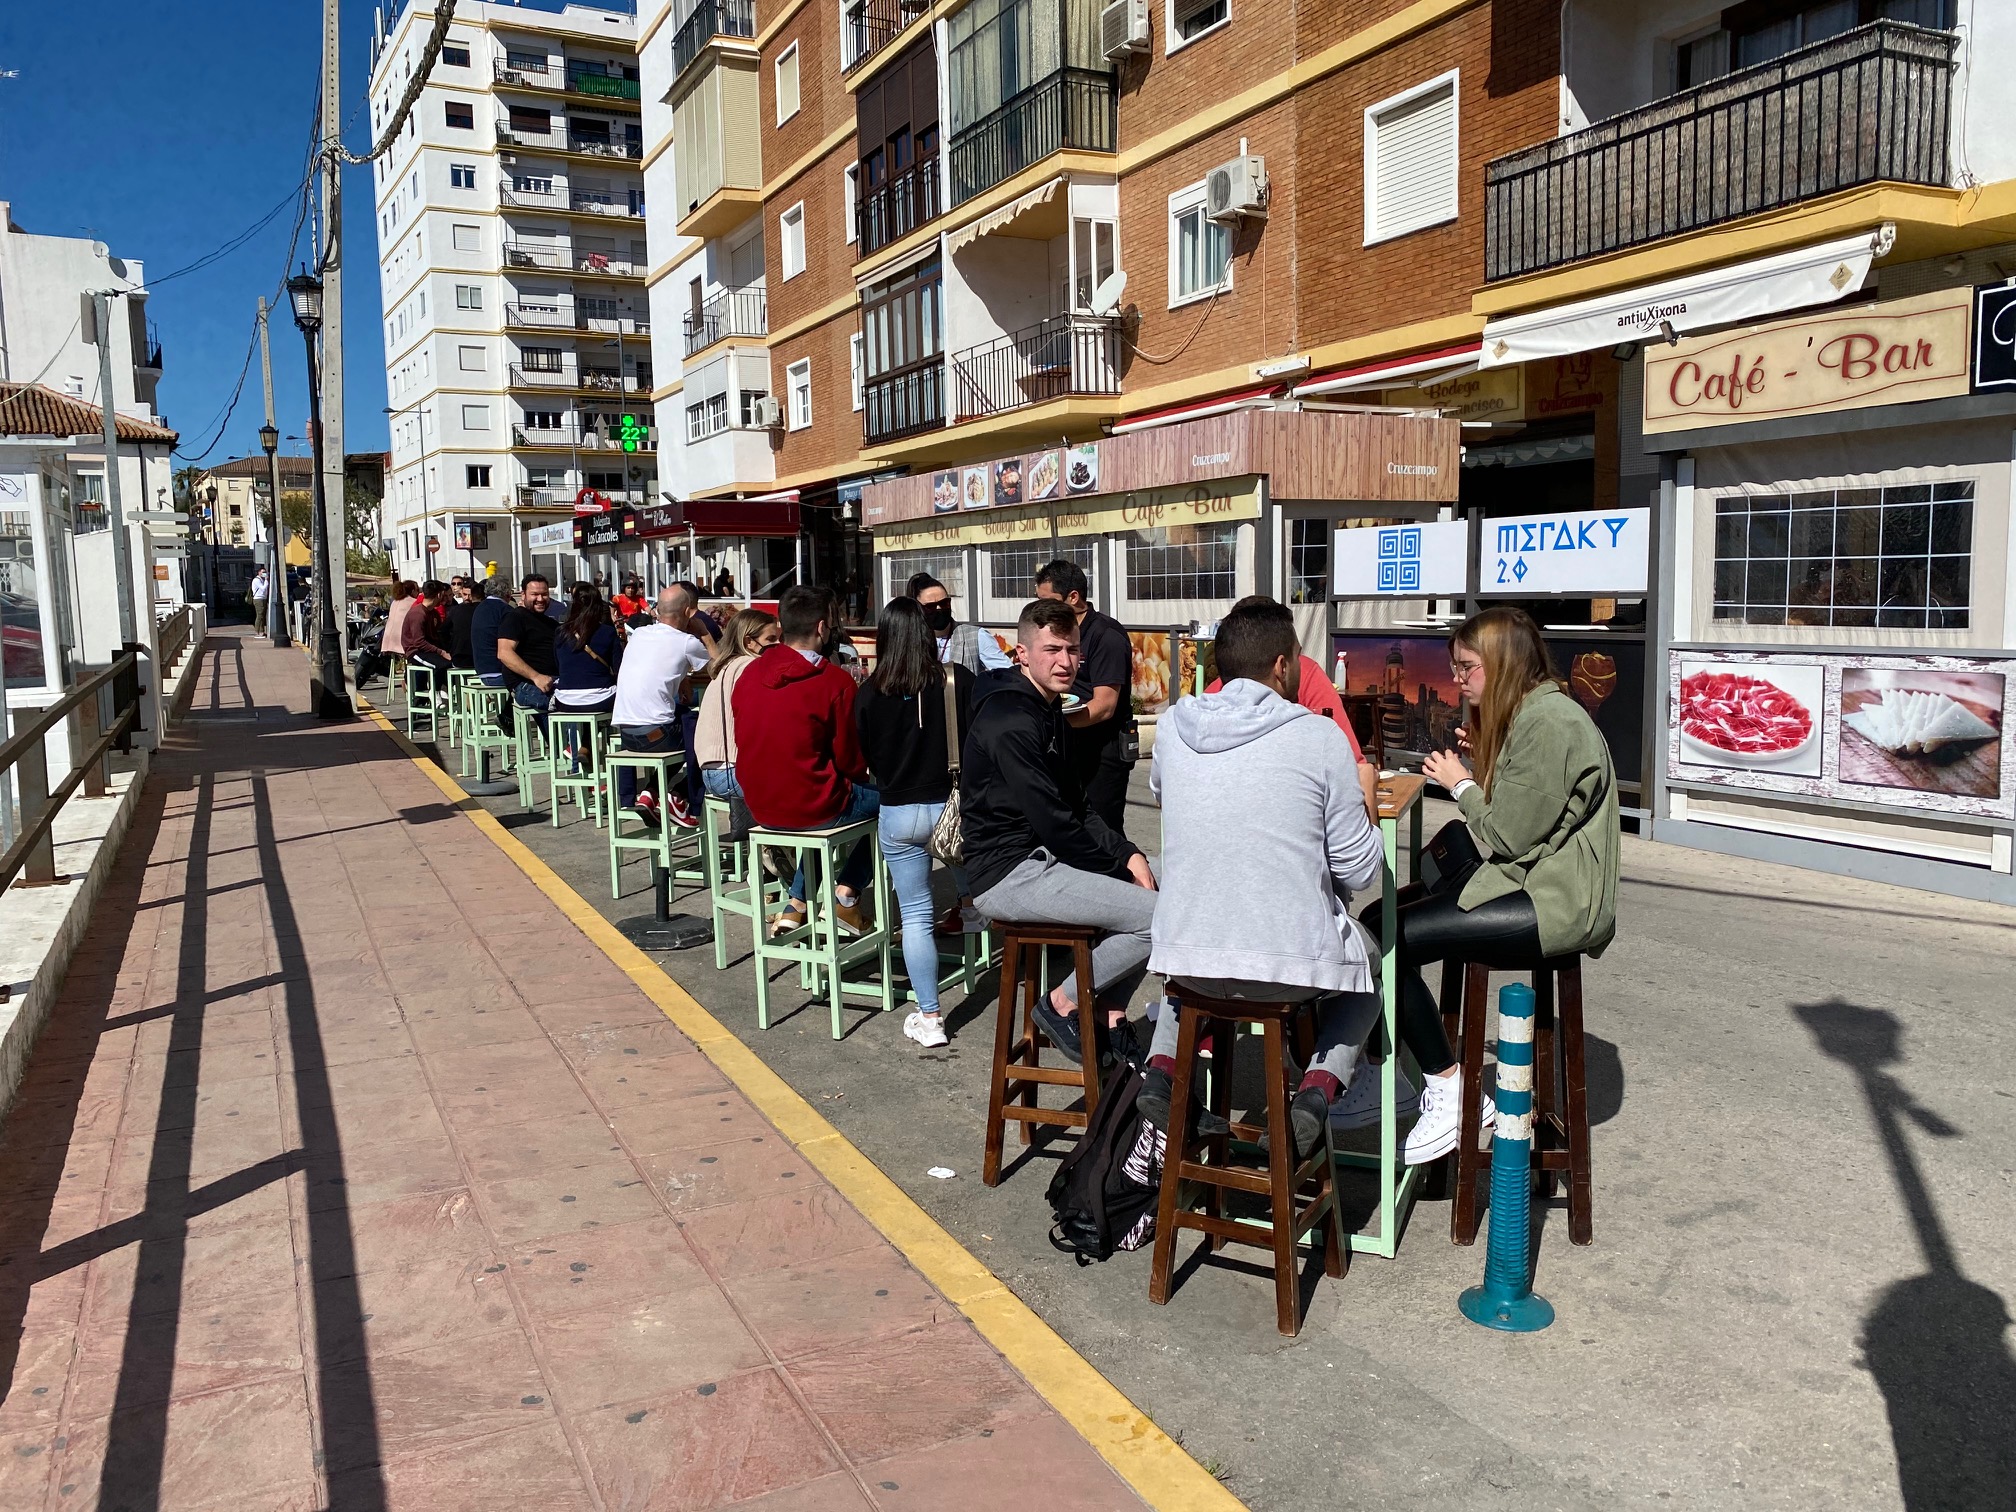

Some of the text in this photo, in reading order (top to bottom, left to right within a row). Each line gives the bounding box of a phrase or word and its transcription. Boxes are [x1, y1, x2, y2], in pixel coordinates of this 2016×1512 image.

[1669, 354, 1765, 409] Café
[1817, 333, 1934, 380] Bar
[1423, 378, 1480, 399] Bodega
[1192, 452, 1230, 467] Cruzcampo
[1387, 462, 1437, 477] Cruzcampo
[1122, 493, 1164, 527] Café
[1184, 486, 1232, 515] Bar
[595, 528, 619, 544] Caracoles
[883, 525, 914, 549] Café
[927, 520, 960, 542] Bar
[982, 511, 1015, 539] Bodega
[1019, 508, 1036, 531] San
